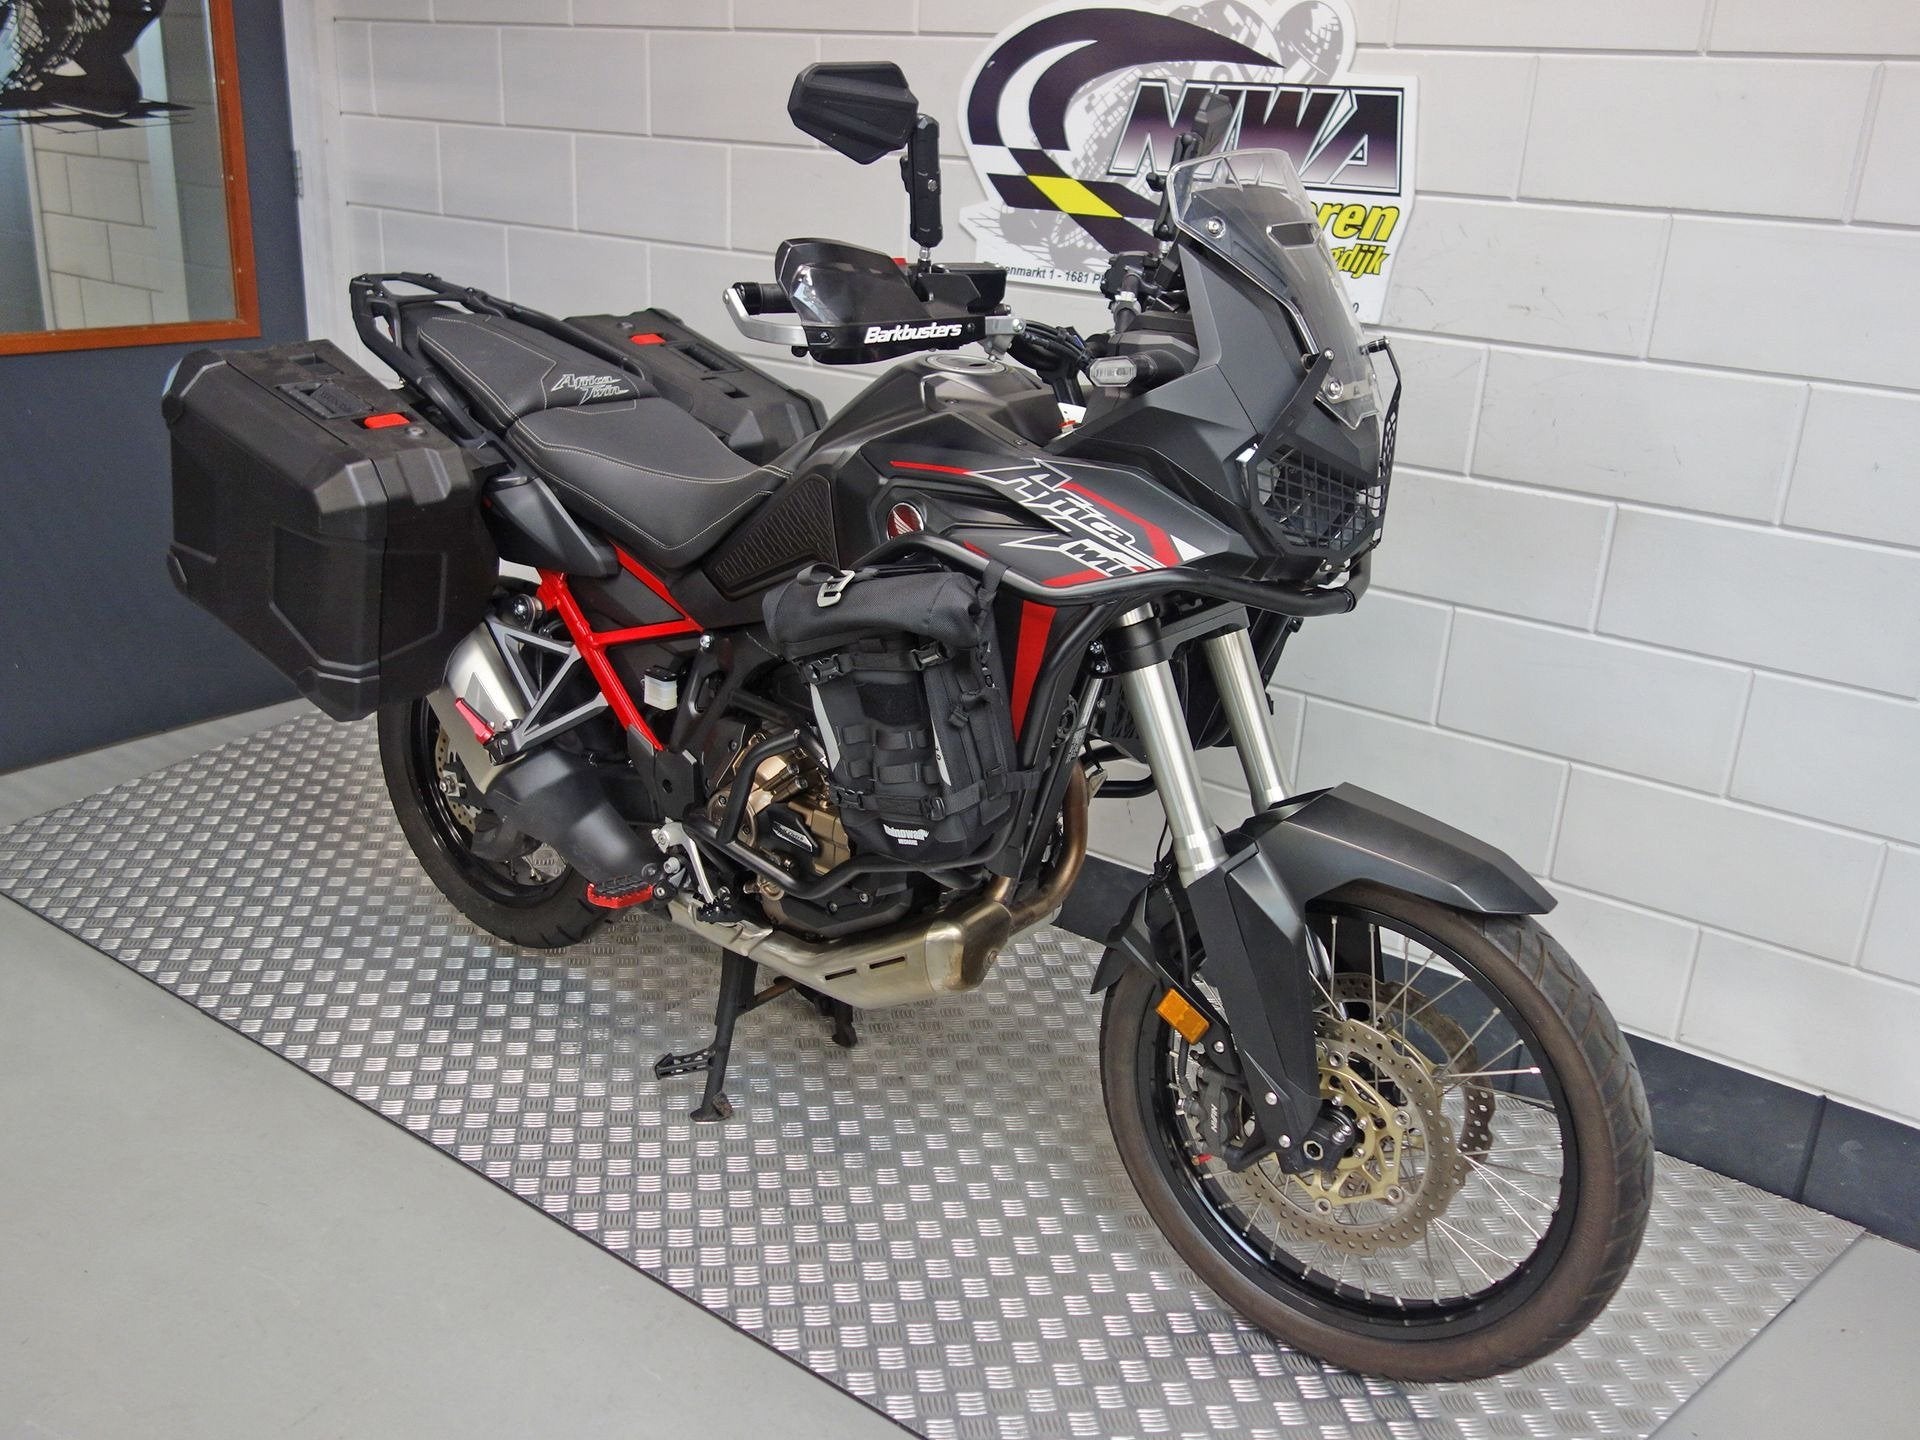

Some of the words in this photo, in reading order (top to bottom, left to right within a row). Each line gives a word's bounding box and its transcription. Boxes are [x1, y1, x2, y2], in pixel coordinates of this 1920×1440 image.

[1311, 201, 1400, 242] ren
[1004, 265, 1046, 279] enmarkt
[1065, 271, 1089, 284] 1681
[864, 322, 963, 344] Barkbusters
